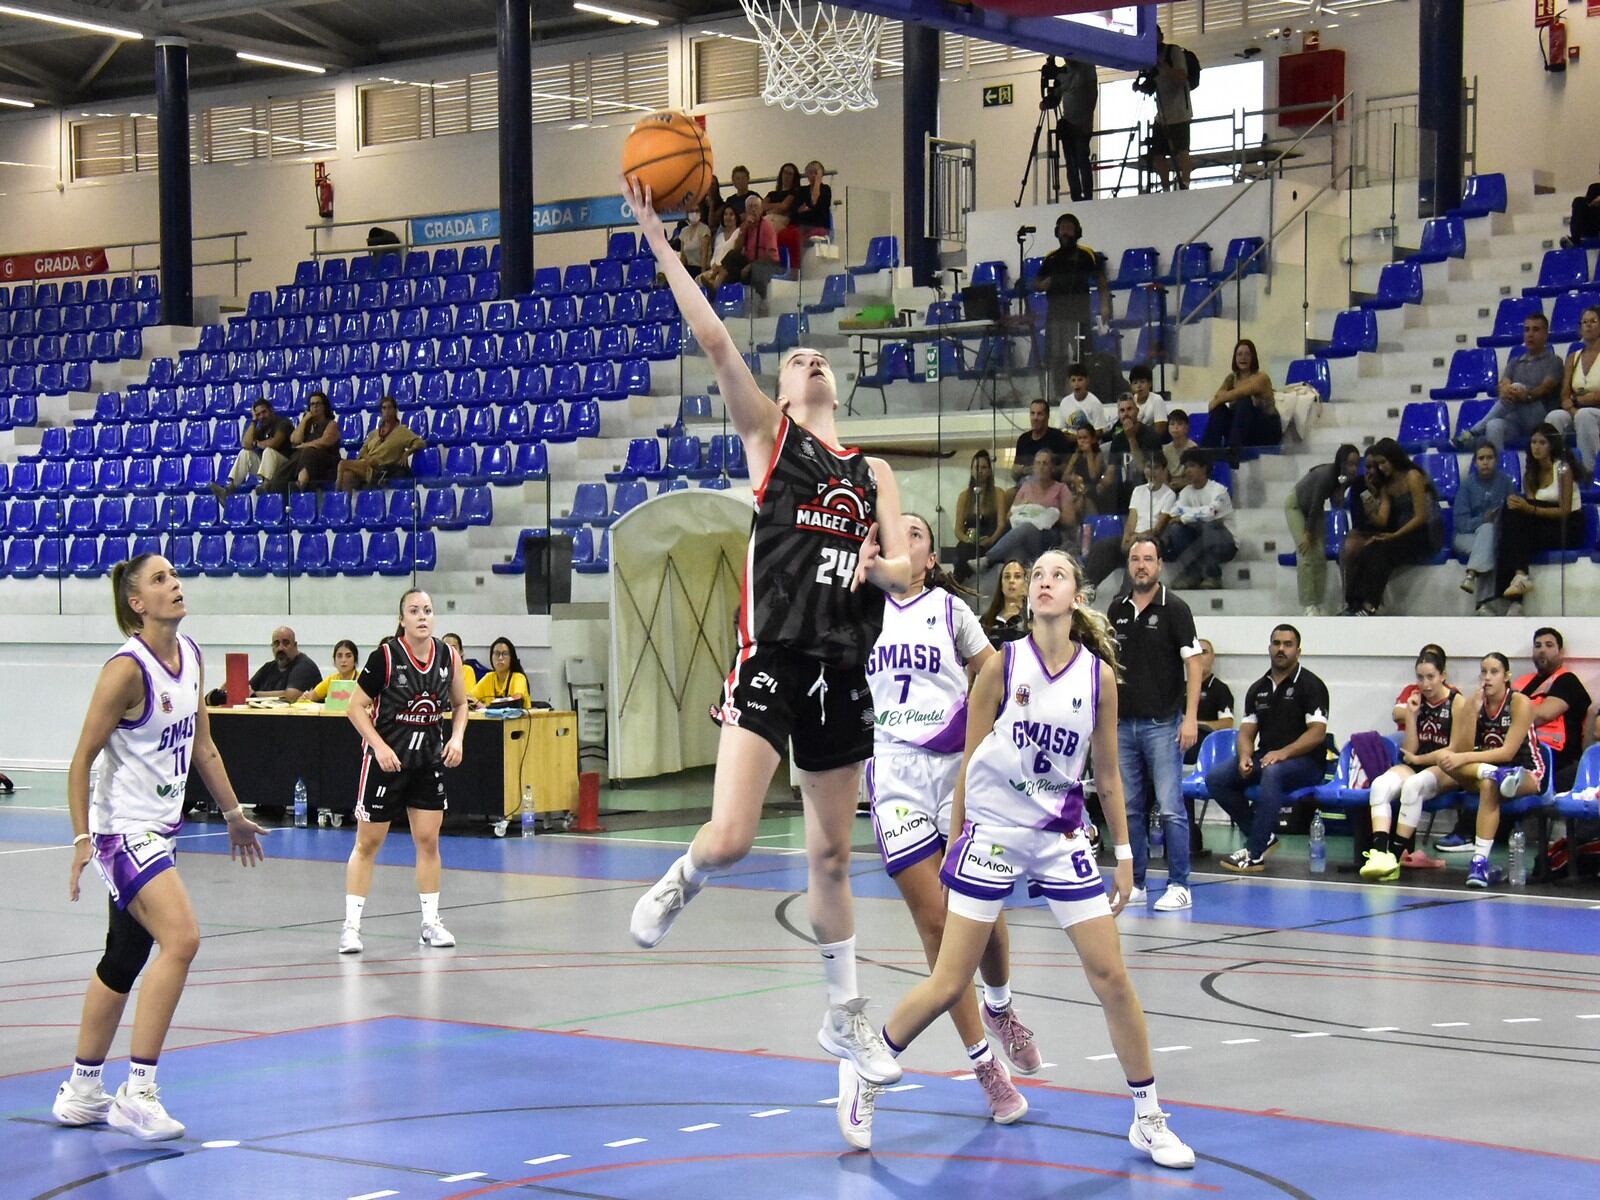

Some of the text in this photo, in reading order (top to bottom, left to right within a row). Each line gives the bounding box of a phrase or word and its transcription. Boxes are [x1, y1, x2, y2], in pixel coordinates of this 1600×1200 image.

[424, 218, 490, 239] GRADA F
[533, 207, 589, 228] RADA F
[34, 255, 94, 273] GRADA G
[796, 508, 851, 533] MAGEC
[815, 547, 858, 588] 24
[866, 643, 941, 676] GMASB
[750, 671, 778, 694] 24
[894, 674, 912, 705] 7
[746, 700, 768, 712] vivo
[395, 713, 428, 723] MAGEC
[888, 709, 945, 727] El Plantel
[408, 731, 425, 751] 11
[1012, 720, 1080, 757] GMASB
[172, 745, 187, 777] 11
[1033, 750, 1052, 774] 6
[885, 814, 929, 841] PLAION
[967, 853, 1014, 874] PLAION
[1070, 850, 1093, 879] 6
